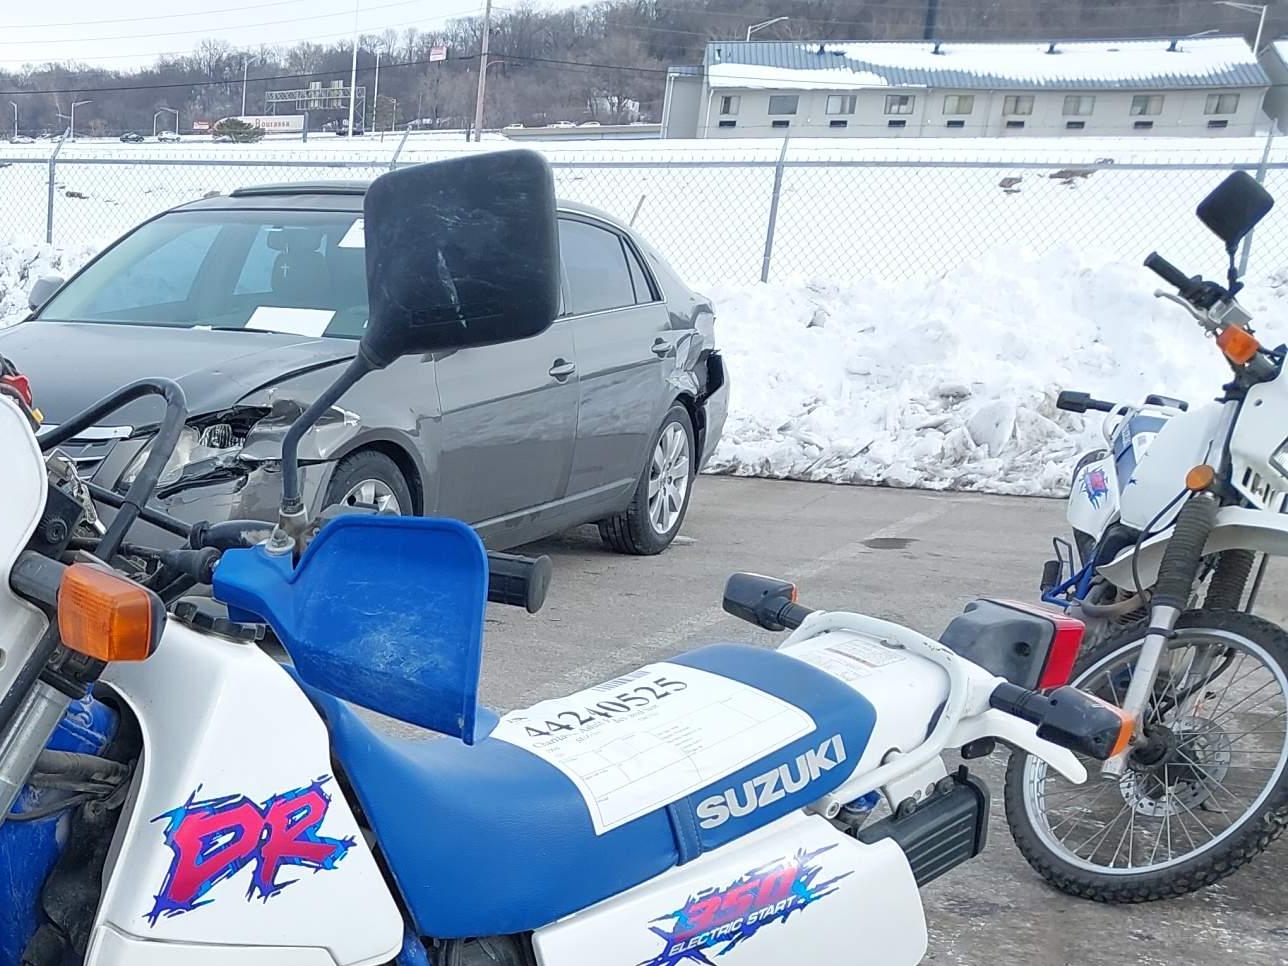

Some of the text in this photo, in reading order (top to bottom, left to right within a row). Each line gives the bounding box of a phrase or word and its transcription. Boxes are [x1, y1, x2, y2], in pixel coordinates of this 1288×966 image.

[524, 677, 688, 738] 44240525
[696, 733, 847, 829] SUZUKI
[160, 784, 346, 908] DR
[669, 897, 797, 956] ELECTRIC START
[673, 865, 800, 942] 350
